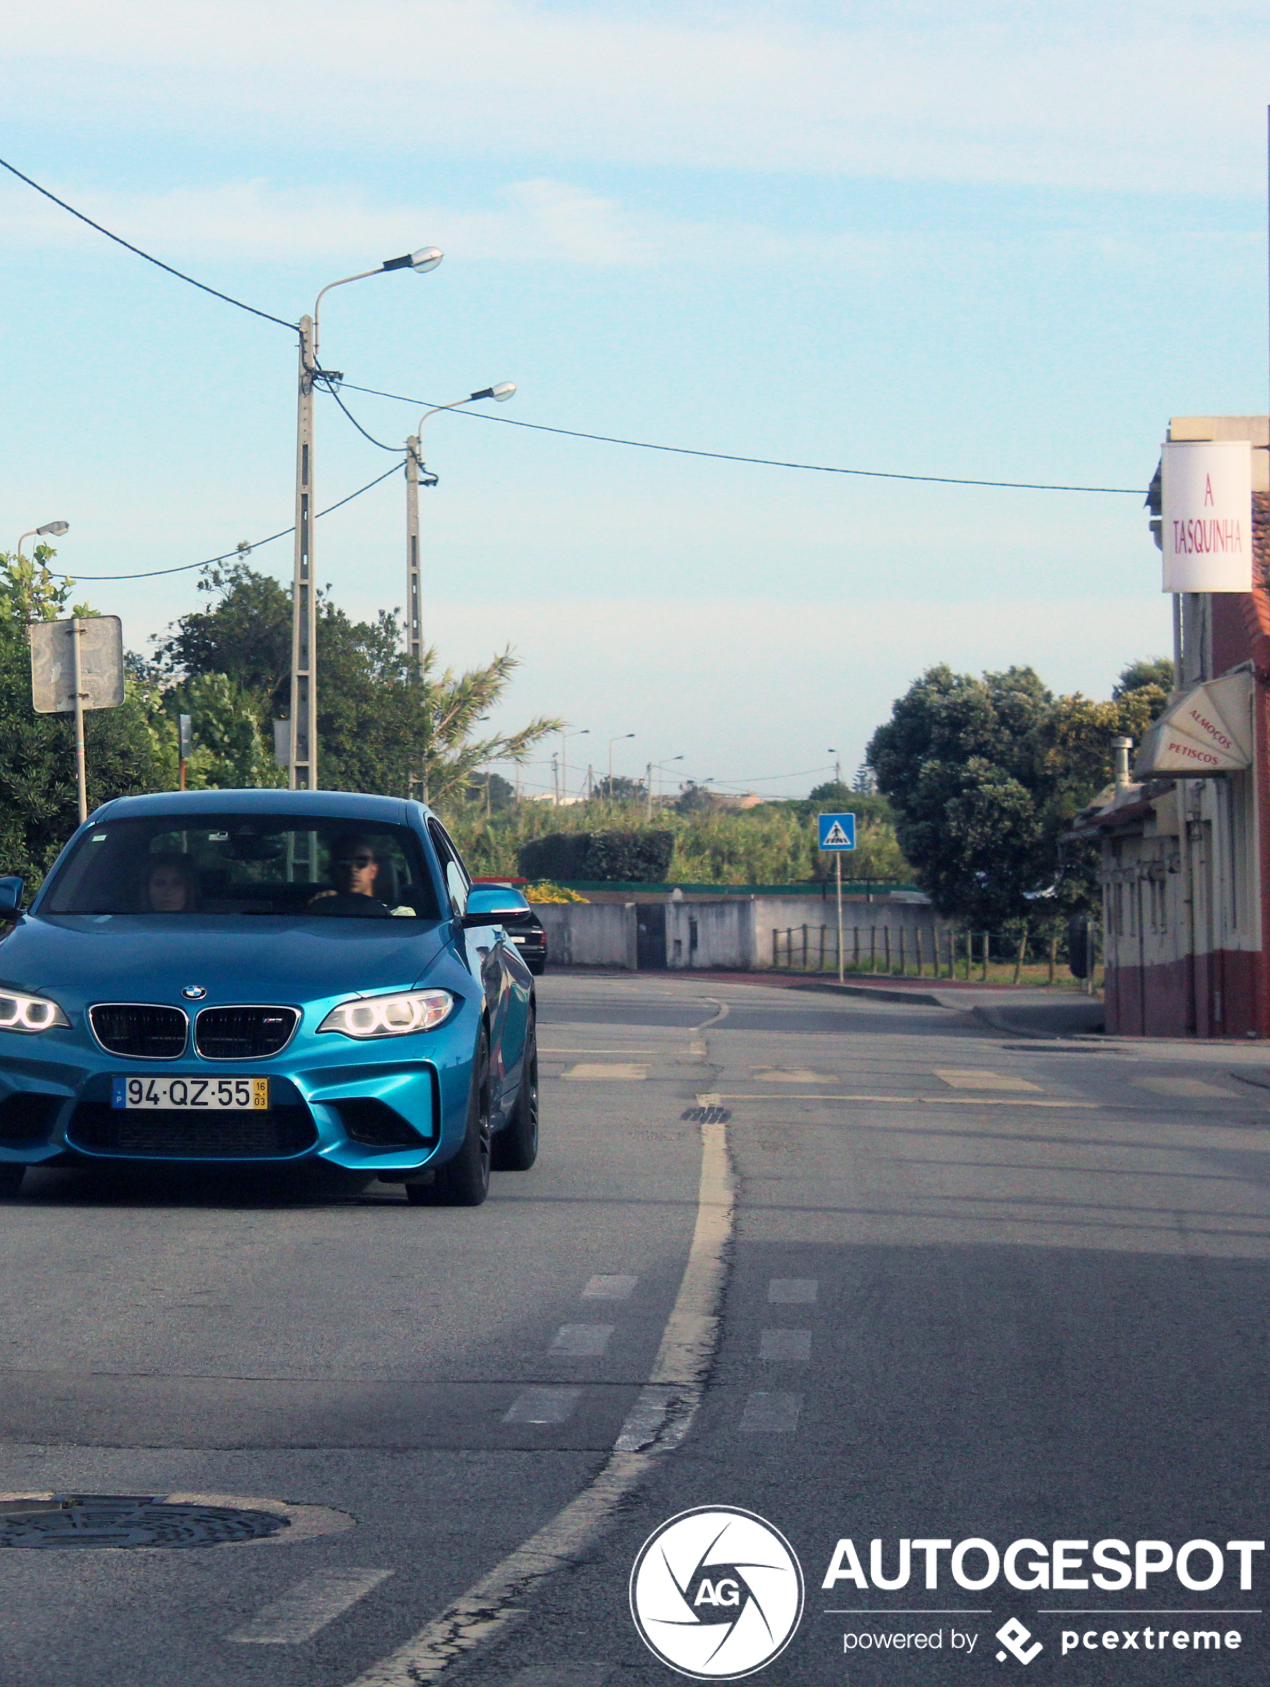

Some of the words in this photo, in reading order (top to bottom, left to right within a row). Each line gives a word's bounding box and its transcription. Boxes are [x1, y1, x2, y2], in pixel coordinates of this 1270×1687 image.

[1204, 473, 1214, 506] A
[1173, 519, 1242, 554] TASQUINHA
[1169, 743, 1218, 765] PETISCOS
[256, 1082, 266, 1091] 16
[254, 1097, 266, 1106] 03
